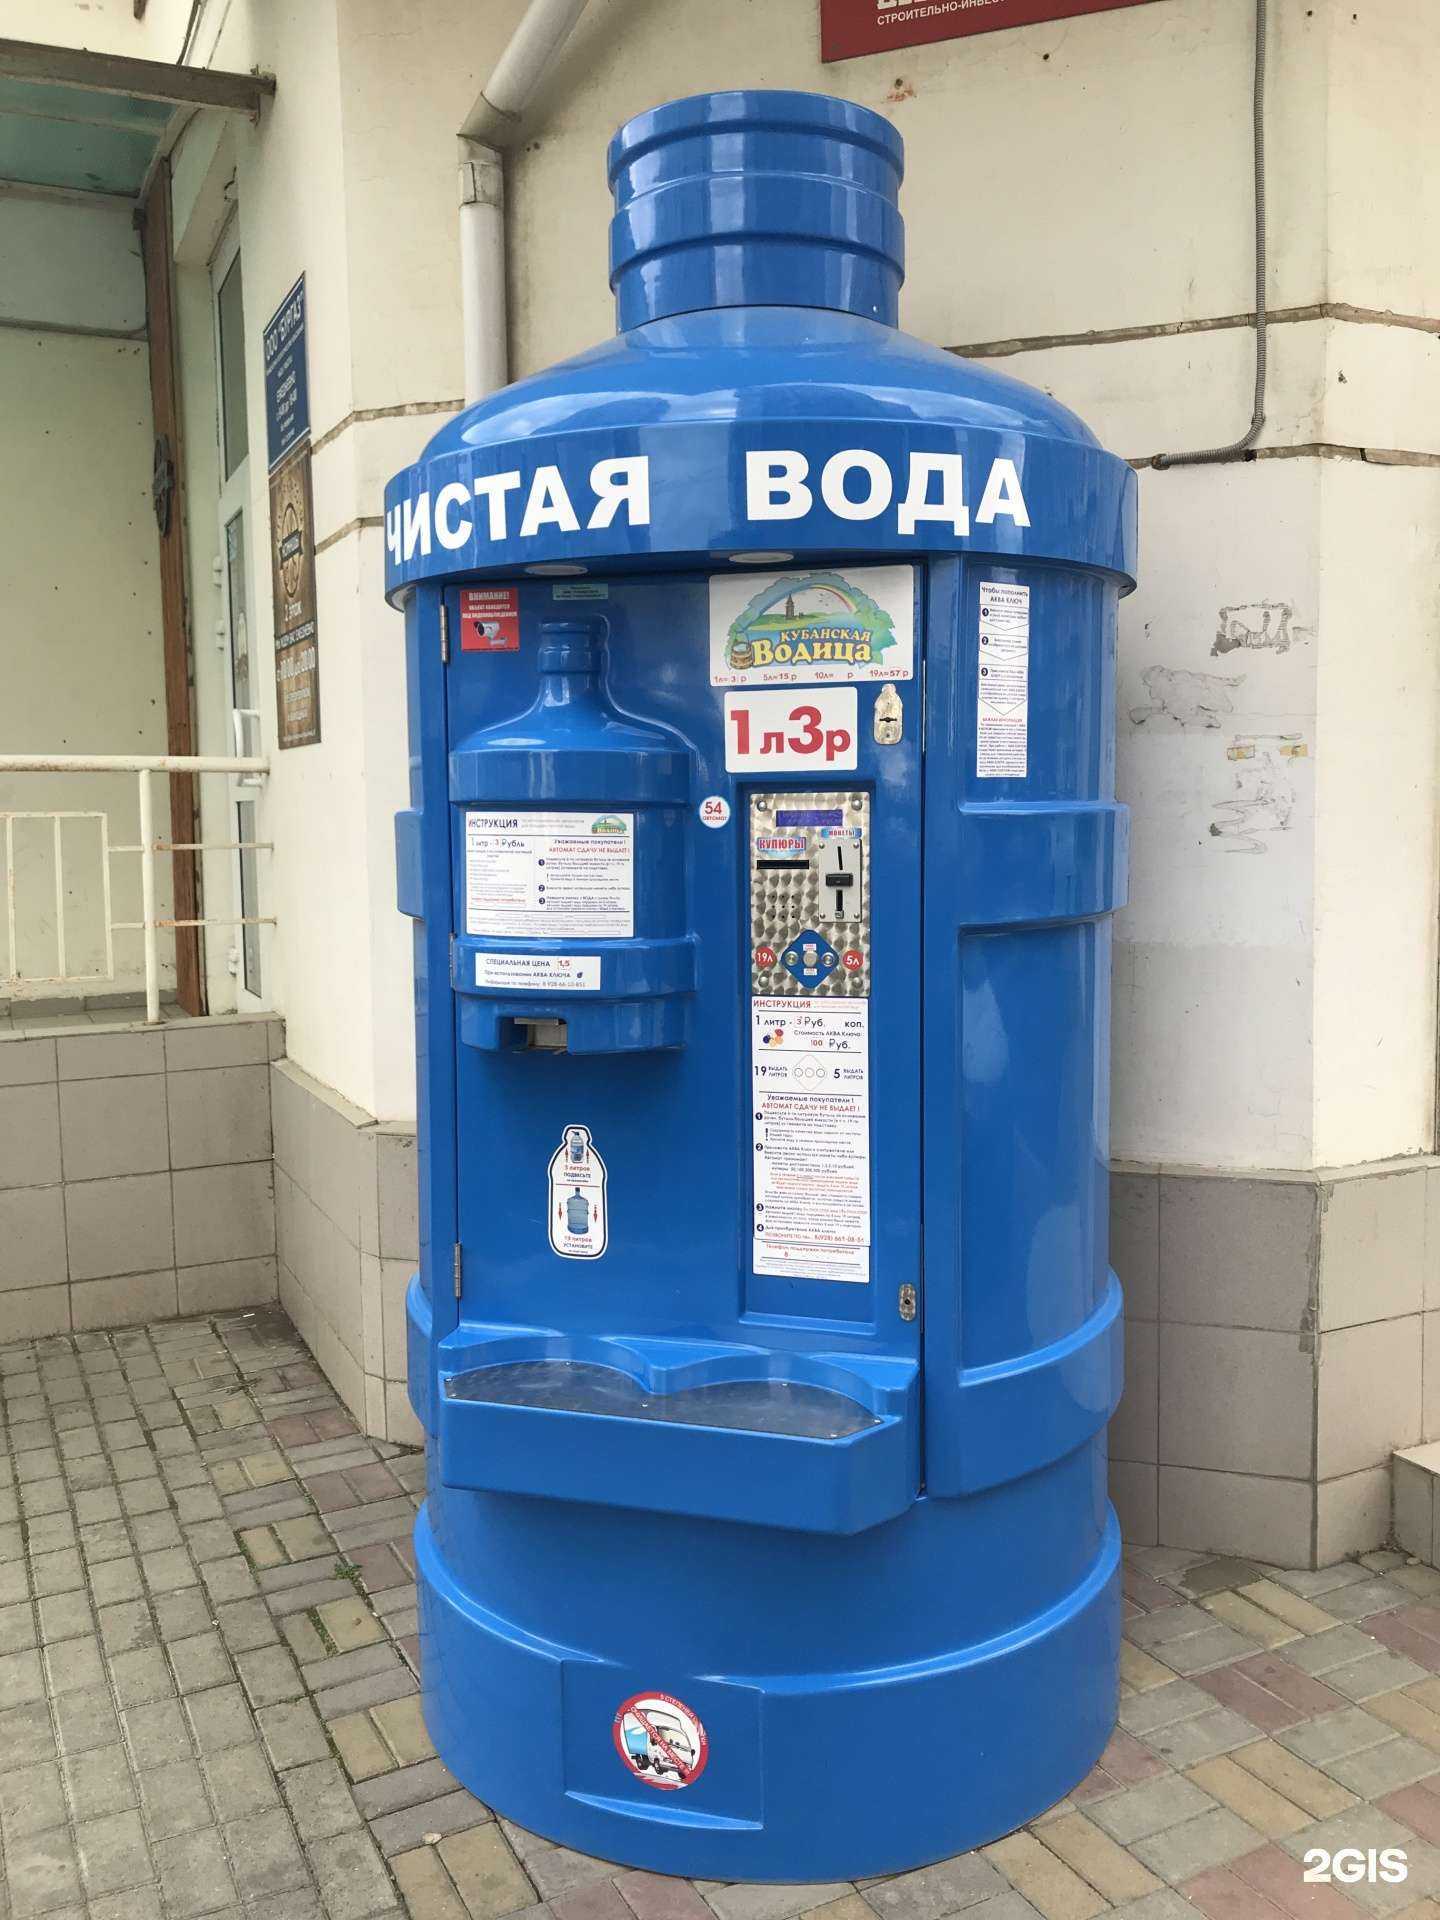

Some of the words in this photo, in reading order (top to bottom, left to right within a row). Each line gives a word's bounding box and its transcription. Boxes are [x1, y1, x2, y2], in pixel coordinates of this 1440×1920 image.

[877, 0, 1005, 25] СТРОИТЕЛЬНО-ИНВЕ
[387, 456, 650, 565] ЧИСТАЯ
[745, 449, 1031, 536] ВОДА
[468, 592, 510, 601] ВНИМАНИЕ!
[781, 628, 872, 642] КУБАНСКАЯ
[704, 802, 723, 815] 54
[468, 818, 518, 829] ИНСТРУКЦИЯ
[759, 838, 805, 850] КУПЮРЫ
[486, 958, 531, 967] СПЕЦИАЛЬНАЯ
[532, 960, 551, 968] ЦЕНА
[757, 952, 774, 964] 19л
[845, 954, 860, 966] 5л
[753, 999, 811, 1009] ИНСТРУКЦИЯ
[756, 1015, 760, 1025] 1
[764, 1019, 786, 1027] литр
[845, 1020, 865, 1028] коп.
[754, 1065, 767, 1076] 19
[834, 1068, 841, 1079] 5
[767, 1094, 808, 1102] Уважаемые
